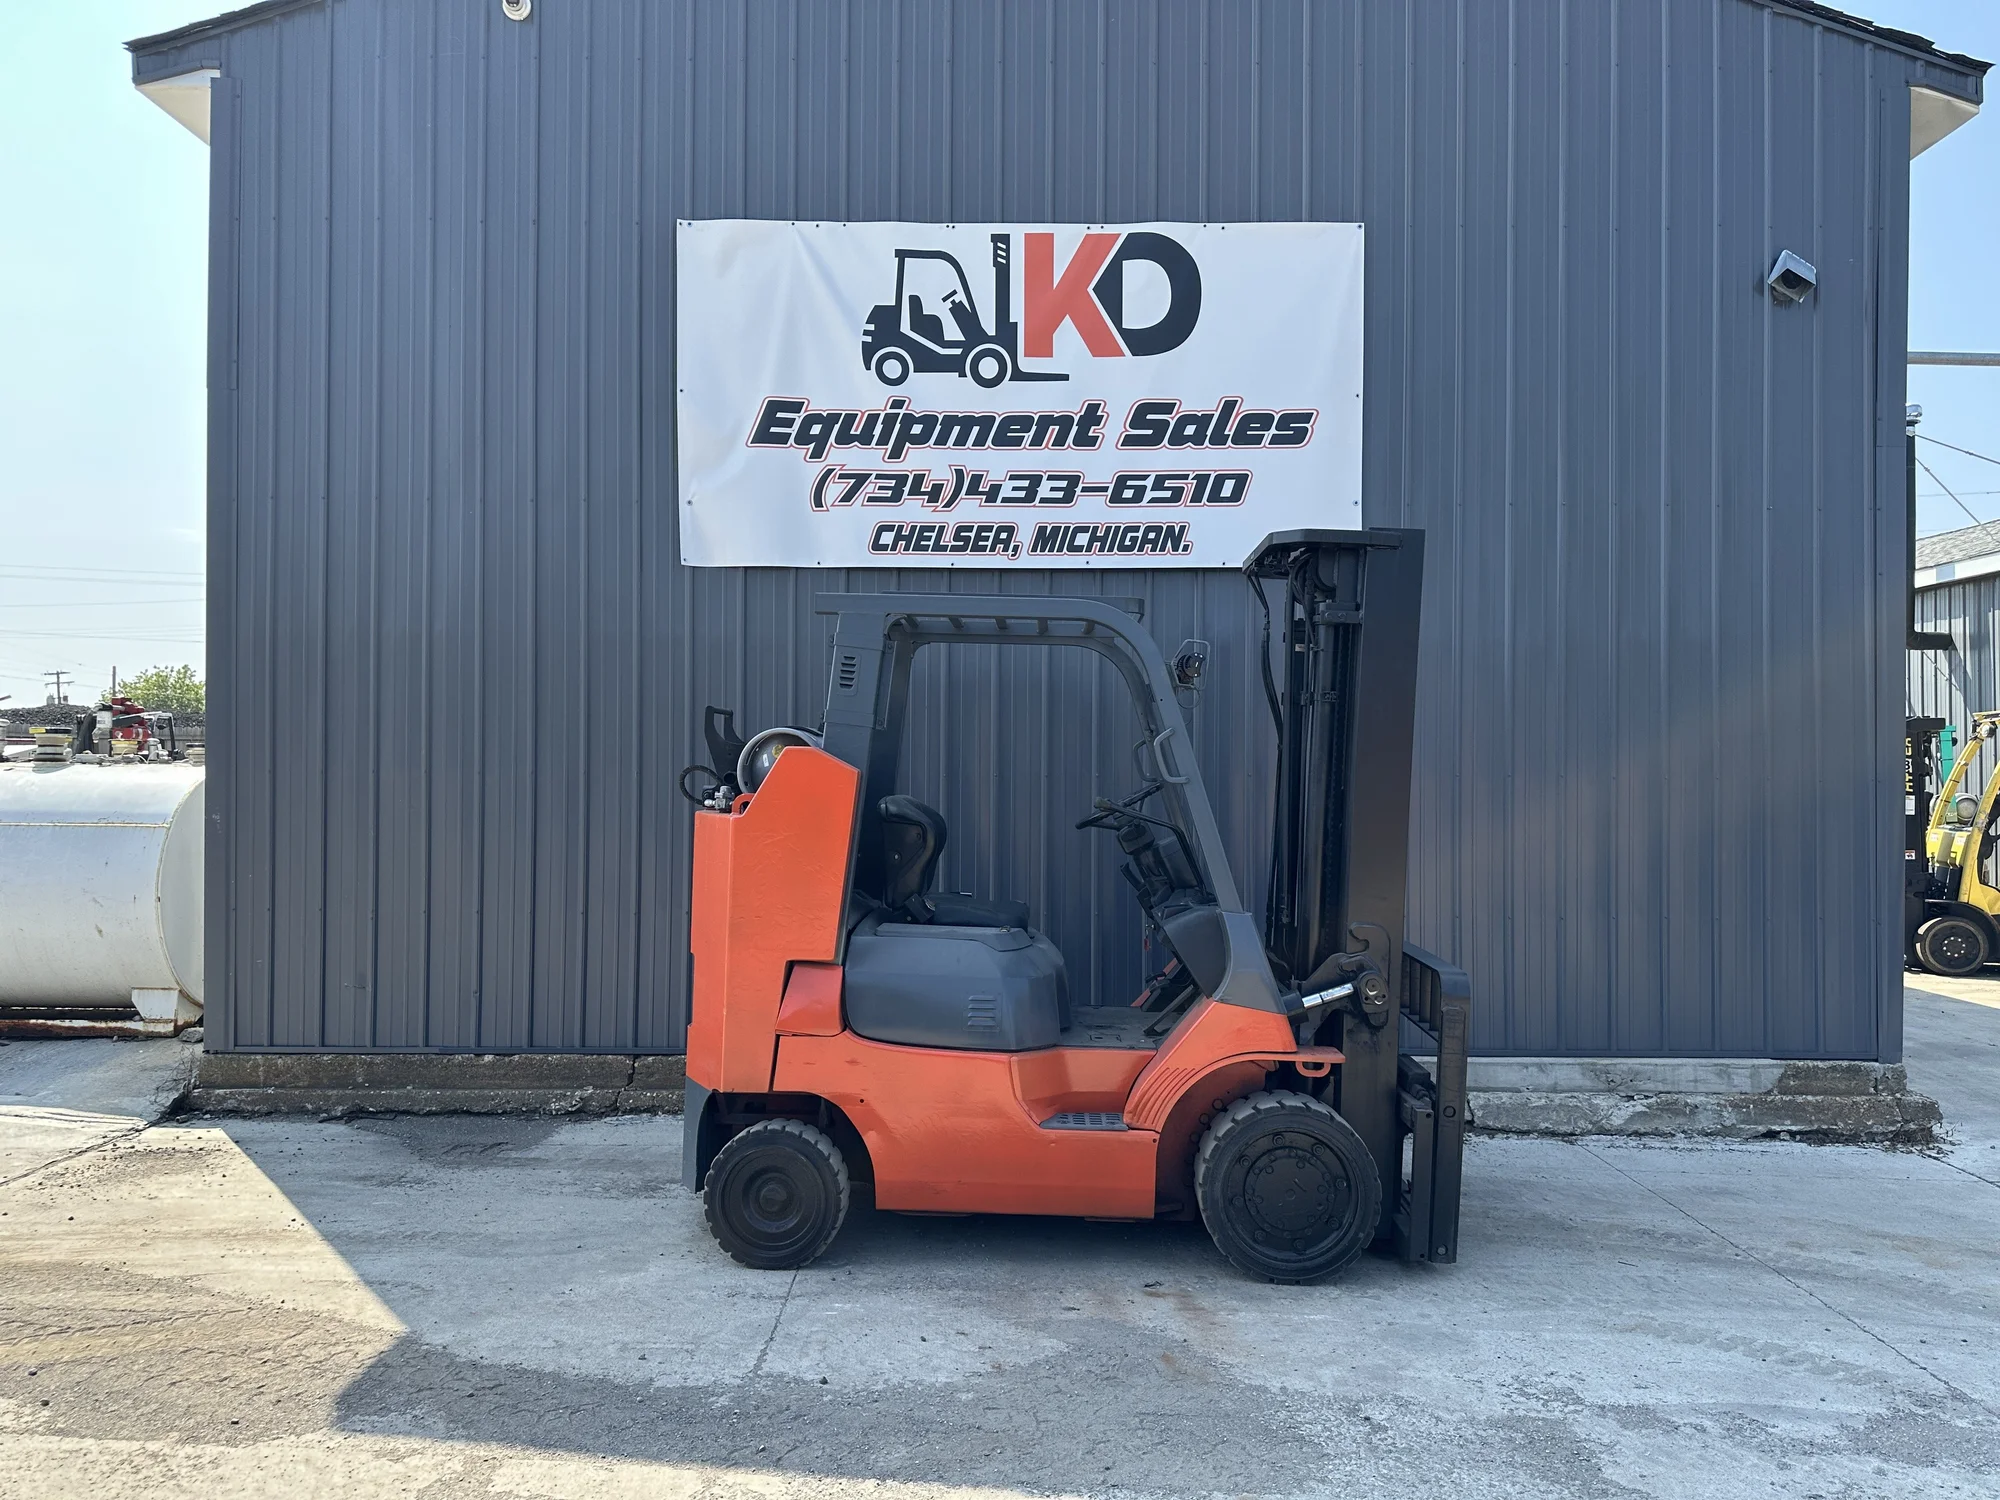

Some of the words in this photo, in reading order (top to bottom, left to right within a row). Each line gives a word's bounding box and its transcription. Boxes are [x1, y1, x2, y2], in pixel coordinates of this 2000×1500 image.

[1024, 232, 1202, 357] KD
[748, 397, 1107, 461] Equipment
[1117, 397, 1318, 449] Sales
[812, 466, 1252, 510] (734)433-6510
[870, 523, 1021, 559] CHELSEA,
[1028, 523, 1191, 554] MICHIGAN.
